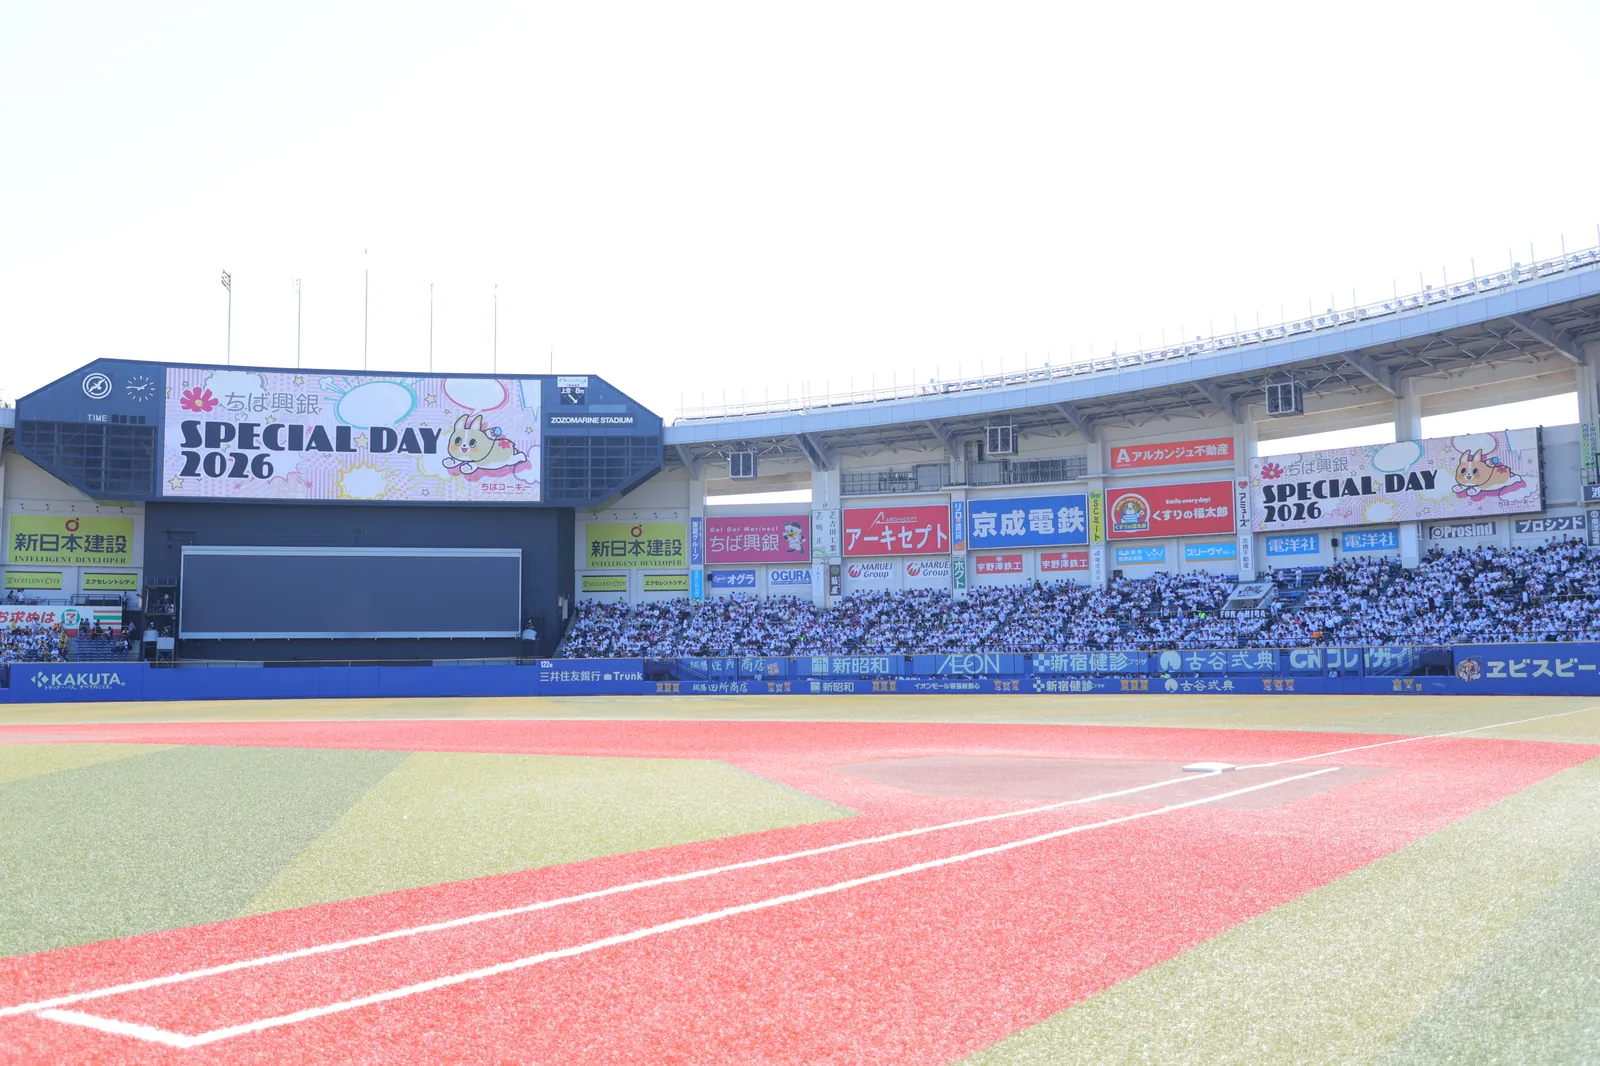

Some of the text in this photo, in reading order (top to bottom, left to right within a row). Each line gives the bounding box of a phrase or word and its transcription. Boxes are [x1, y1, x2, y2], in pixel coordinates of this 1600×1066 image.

[224, 391, 320, 415] ちば興銀
[88, 414, 108, 422] TIME
[180, 420, 442, 454] SPECIAL DAY
[1132, 444, 1229, 462] アルカンジュ不動産
[179, 450, 274, 479] 2026
[1287, 457, 1348, 476] ちば興銀
[481, 482, 532, 491] ちばコーギー
[1262, 470, 1438, 504] SPECIAL DAY
[1152, 506, 1228, 521] くすりの福太郎
[1238, 492, 1250, 528] アミューズ
[1264, 501, 1322, 523] 2026
[972, 506, 1086, 538] 京成電鉄
[1444, 522, 1493, 535] Prosind
[1519, 517, 1583, 532] プロシンド
[14, 532, 128, 554] 新日本建設
[709, 534, 780, 554] ちば興銀
[846, 523, 948, 551] アーキセプト
[1268, 536, 1317, 553] 電洋社
[1344, 531, 1396, 549] 電洋社
[590, 539, 682, 557] 新日本建設
[862, 562, 892, 571] MARUEI
[920, 560, 950, 569] MARUE
[922, 569, 948, 577] Group
[727, 574, 754, 584] オグラ
[772, 570, 812, 581] OGURA
[954, 562, 964, 588] ホクト
[832, 657, 889, 674] 新昭和
[1184, 650, 1276, 670] 古谷式典
[52, 672, 121, 686] KAKUTA
[540, 671, 643, 682] 三井住友銀行 Trunk
[822, 682, 854, 692] 新昭和
[1180, 680, 1235, 691] 古谷式典
